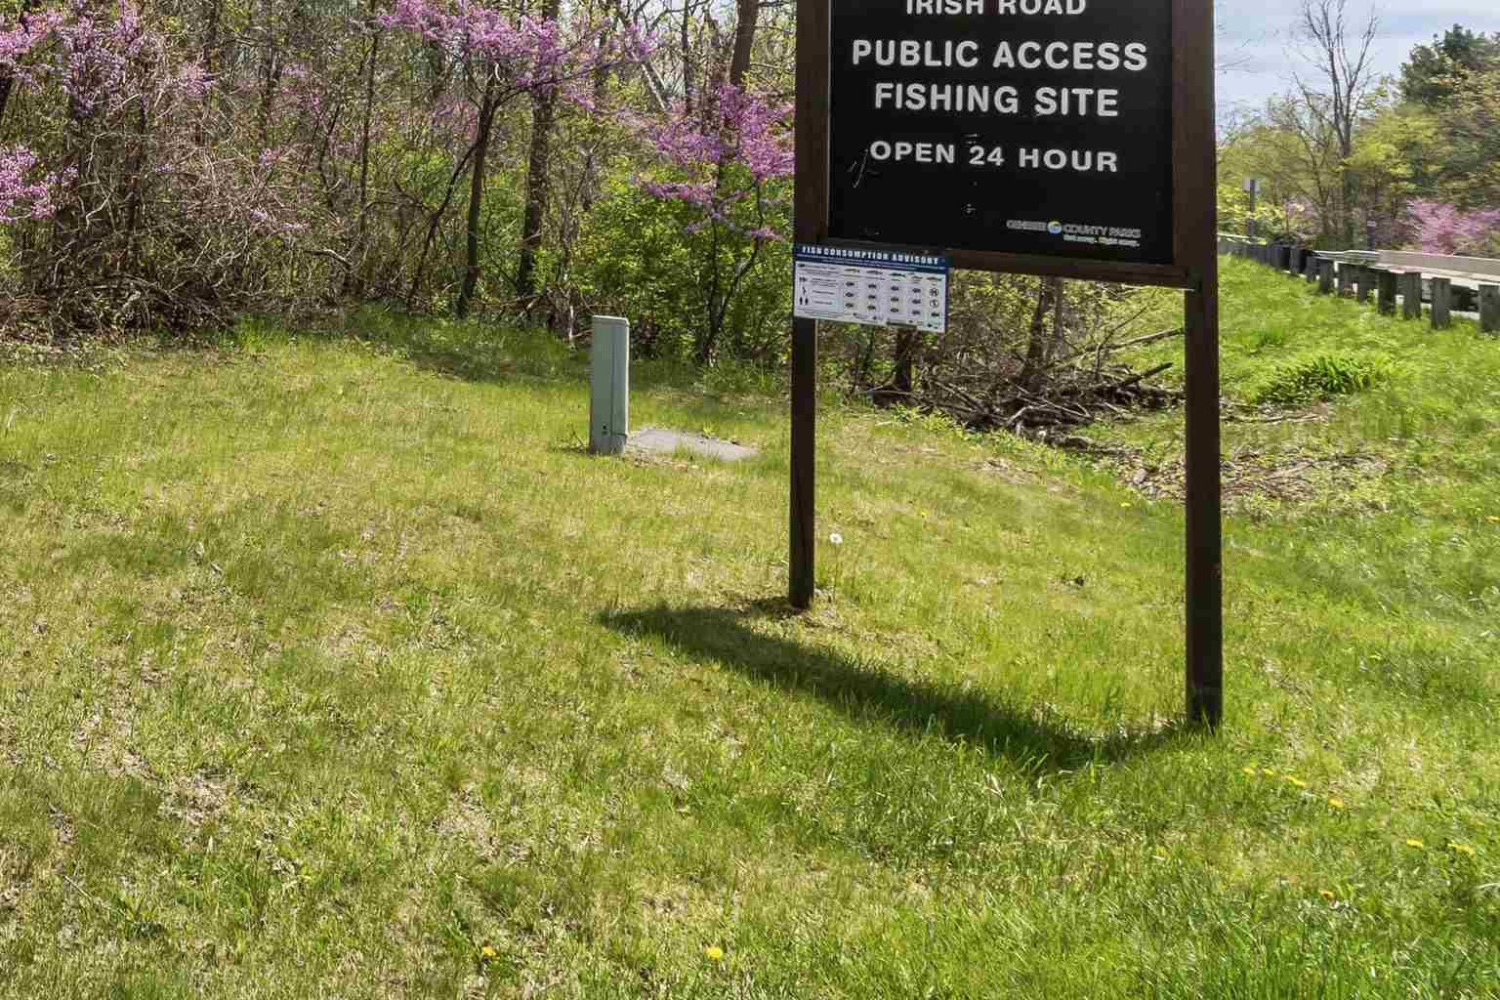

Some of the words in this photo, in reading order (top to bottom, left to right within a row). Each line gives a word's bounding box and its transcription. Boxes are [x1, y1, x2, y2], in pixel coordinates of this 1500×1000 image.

[852, 39, 980, 68] PUBLIC
[993, 42, 1148, 72] ACCESS
[875, 83, 1019, 113] FISHING
[1034, 87, 1119, 117] SITE
[870, 140, 955, 164] OPEN
[968, 144, 1004, 166] 24
[1019, 148, 1118, 172] HOUR
[823, 247, 889, 261] CONSUMPTION
[892, 253, 940, 265] ADVISORY
